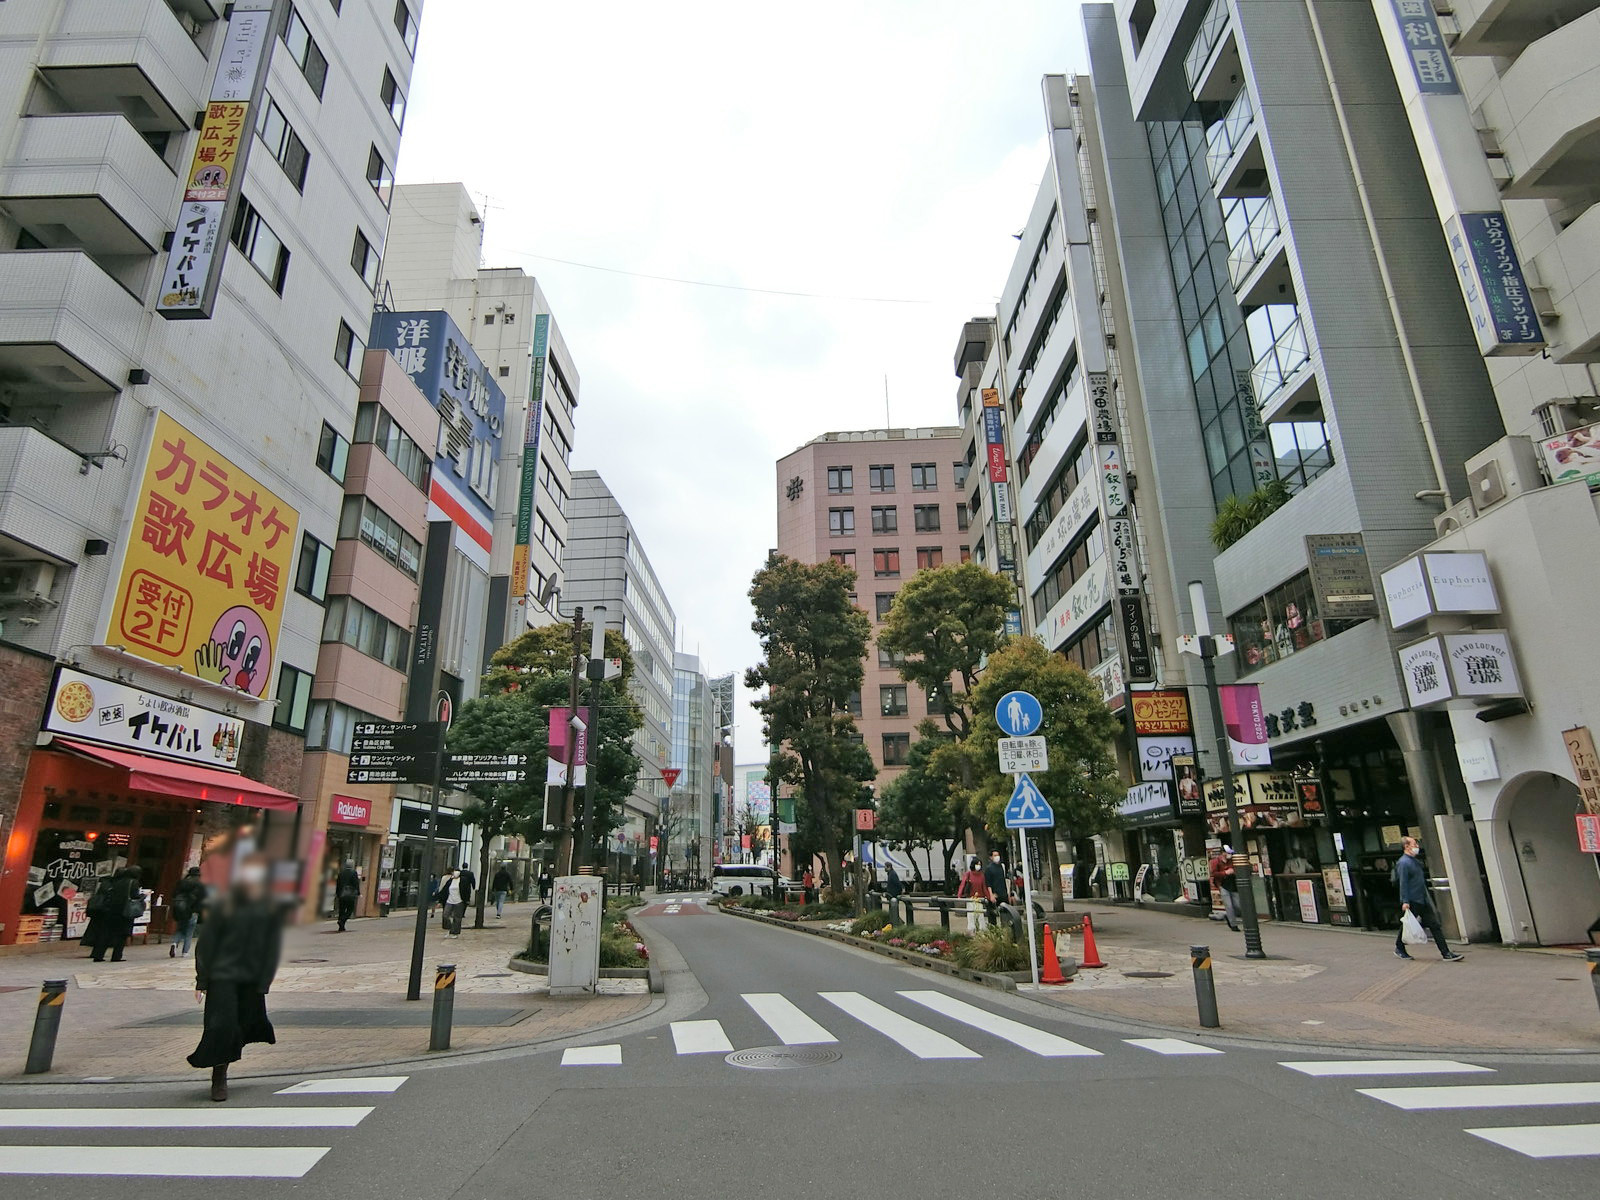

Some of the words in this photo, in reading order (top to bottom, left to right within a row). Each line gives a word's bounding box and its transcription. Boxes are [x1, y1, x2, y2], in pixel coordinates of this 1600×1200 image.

[223, 90, 240, 99] 5F
[198, 104, 228, 163] 歌広場
[217, 104, 245, 163] カラオケ
[172, 217, 207, 289] イケバル
[445, 338, 504, 439] 洋服の
[1092, 386, 1112, 432] 塚田農場
[1101, 433, 1113, 441] 5F
[435, 387, 500, 511] 青山
[156, 438, 290, 550] カラオケ
[142, 491, 280, 611] 歌広場
[1388, 581, 1423, 602] Euphoria
[1433, 576, 1487, 586] Euphoria
[136, 578, 186, 621] 受付
[131, 611, 179, 646] 2F
[1007, 624, 1019, 633] 3F
[1405, 653, 1419, 671] PIANO
[1419, 650, 1440, 661] LOUNGE
[1452, 643, 1475, 658] PIANO
[1475, 642, 1506, 658] LOUNGE
[102, 707, 123, 722] 池袋
[1153, 699, 1183, 709] やきとり
[1155, 709, 1186, 719] センター
[1251, 700, 1259, 722] TOKYO
[1255, 723, 1264, 740] 2020
[128, 711, 202, 753] イケバル
[1001, 740, 1042, 750] 自転車を除く
[1007, 761, 1016, 769] 12
[337, 800, 366, 818] Rakuten
[47, 858, 95, 879] イケバル
